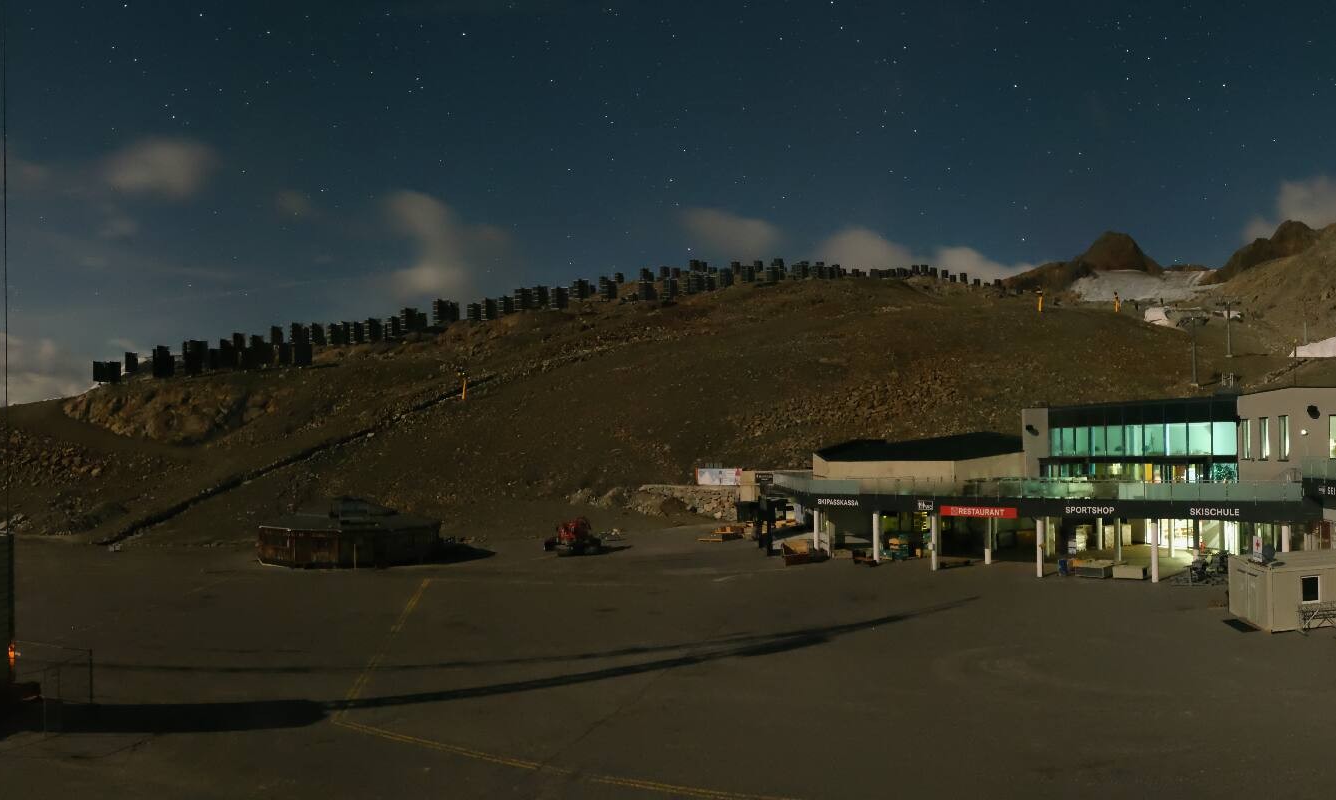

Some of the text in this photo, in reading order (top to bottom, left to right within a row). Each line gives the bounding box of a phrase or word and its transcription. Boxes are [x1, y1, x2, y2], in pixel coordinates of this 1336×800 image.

[817, 498, 859, 507] SKIPASSKASSA
[958, 507, 1005, 517] RESTAURANT
[1065, 506, 1115, 515] SPORTSHOP
[1189, 507, 1240, 517] SKISCHULE
